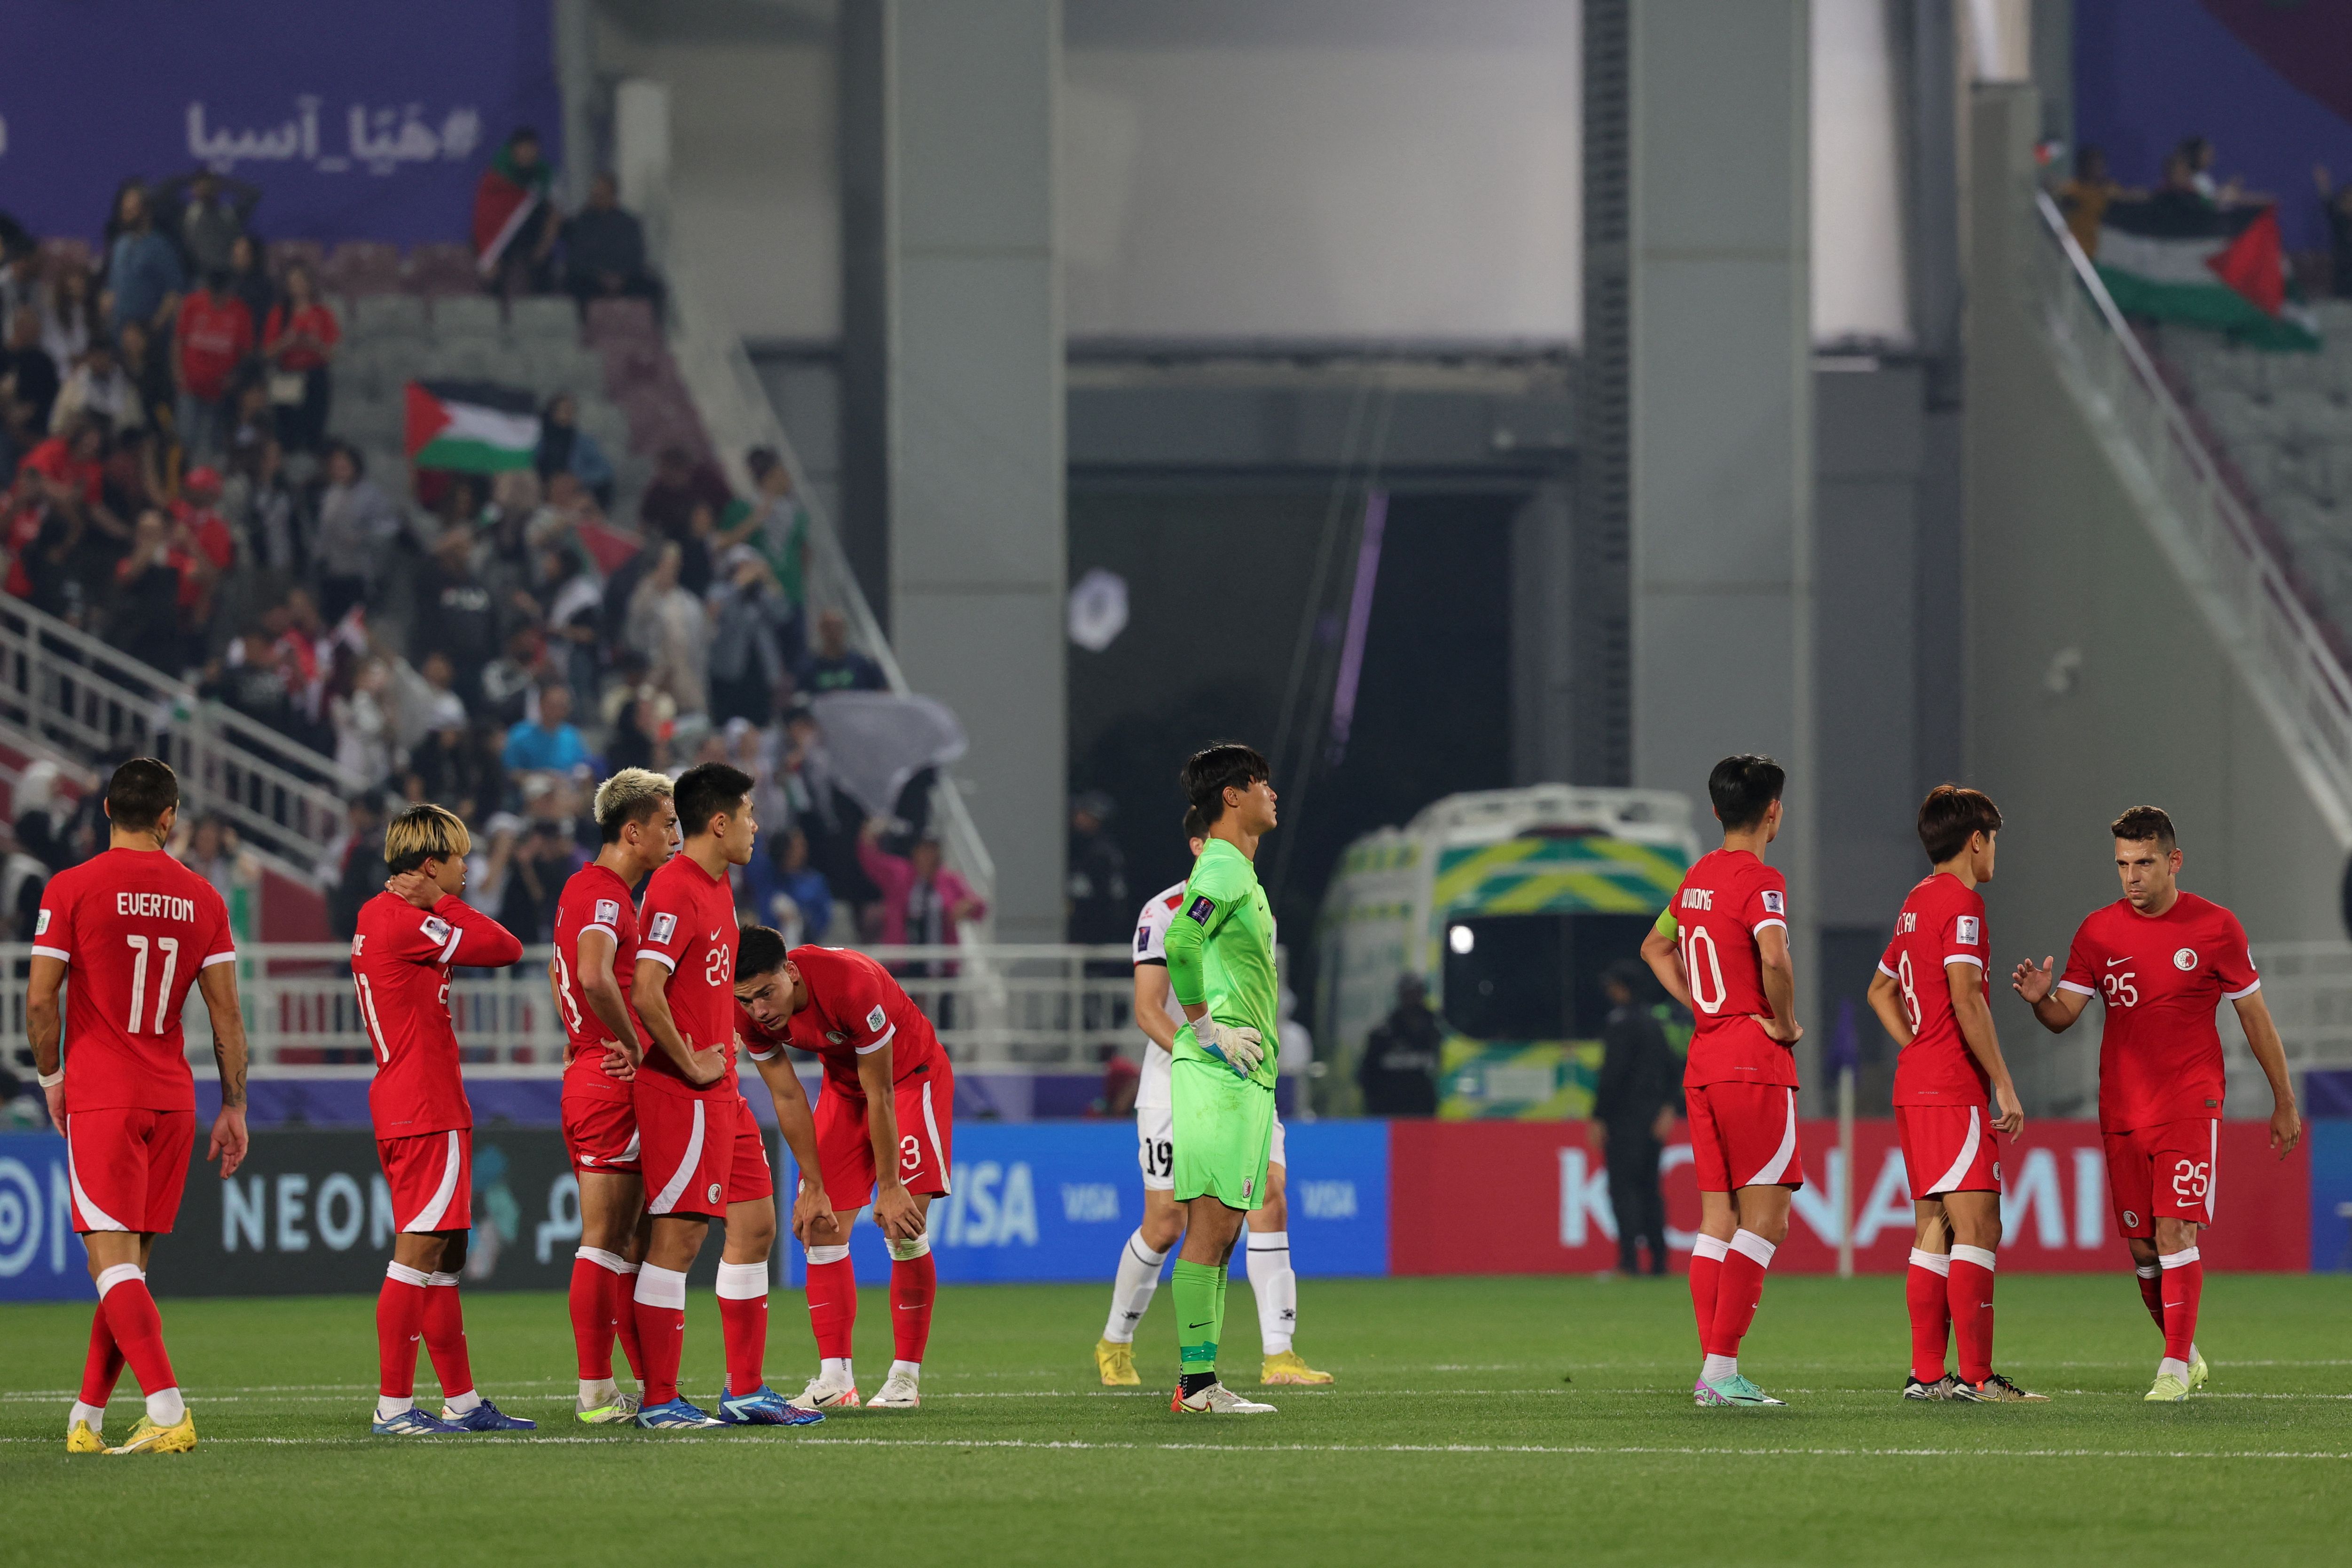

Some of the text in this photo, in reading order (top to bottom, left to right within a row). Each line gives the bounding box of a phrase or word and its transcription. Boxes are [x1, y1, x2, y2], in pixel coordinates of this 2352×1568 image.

[117, 893, 194, 923] EVERTON
[127, 934, 179, 1034] 11
[706, 943, 730, 987] 23
[1678, 925, 1726, 1014] 10
[1898, 949, 1922, 1035] 8
[2103, 972, 2139, 1007] 25
[900, 1135, 921, 1170] 3
[1146, 1137, 1173, 1177] 19
[2172, 1159, 2209, 1197] 25
